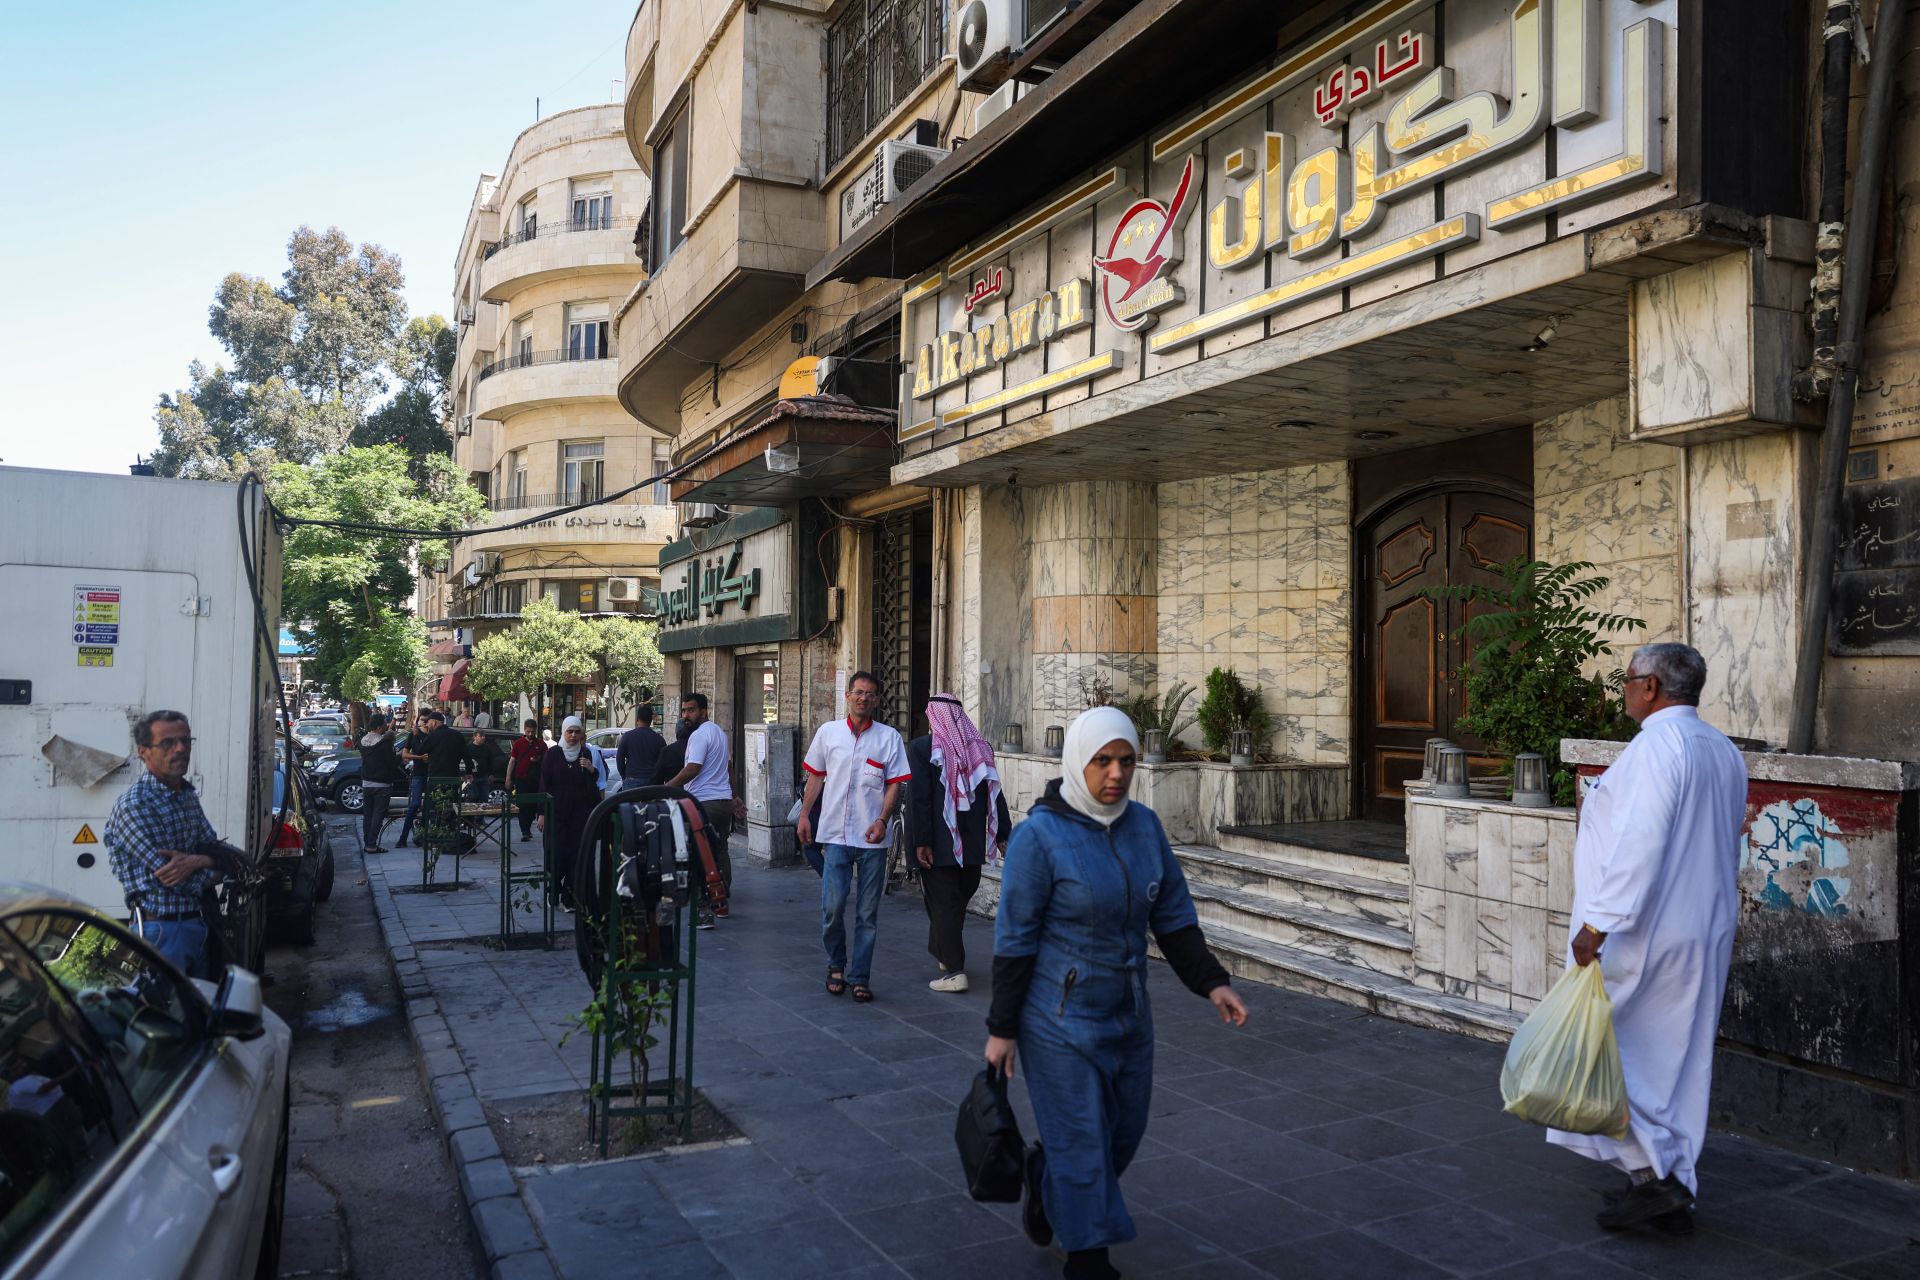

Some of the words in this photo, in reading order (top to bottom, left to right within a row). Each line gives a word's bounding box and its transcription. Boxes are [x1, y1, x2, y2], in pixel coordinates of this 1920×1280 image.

[1313, 29, 1422, 122] نادي
[1209, 0, 1588, 269] الكروان
[964, 265, 1003, 314] ملهى
[911, 278, 1085, 399] Alkarawan
[612, 515, 647, 529] فندق
